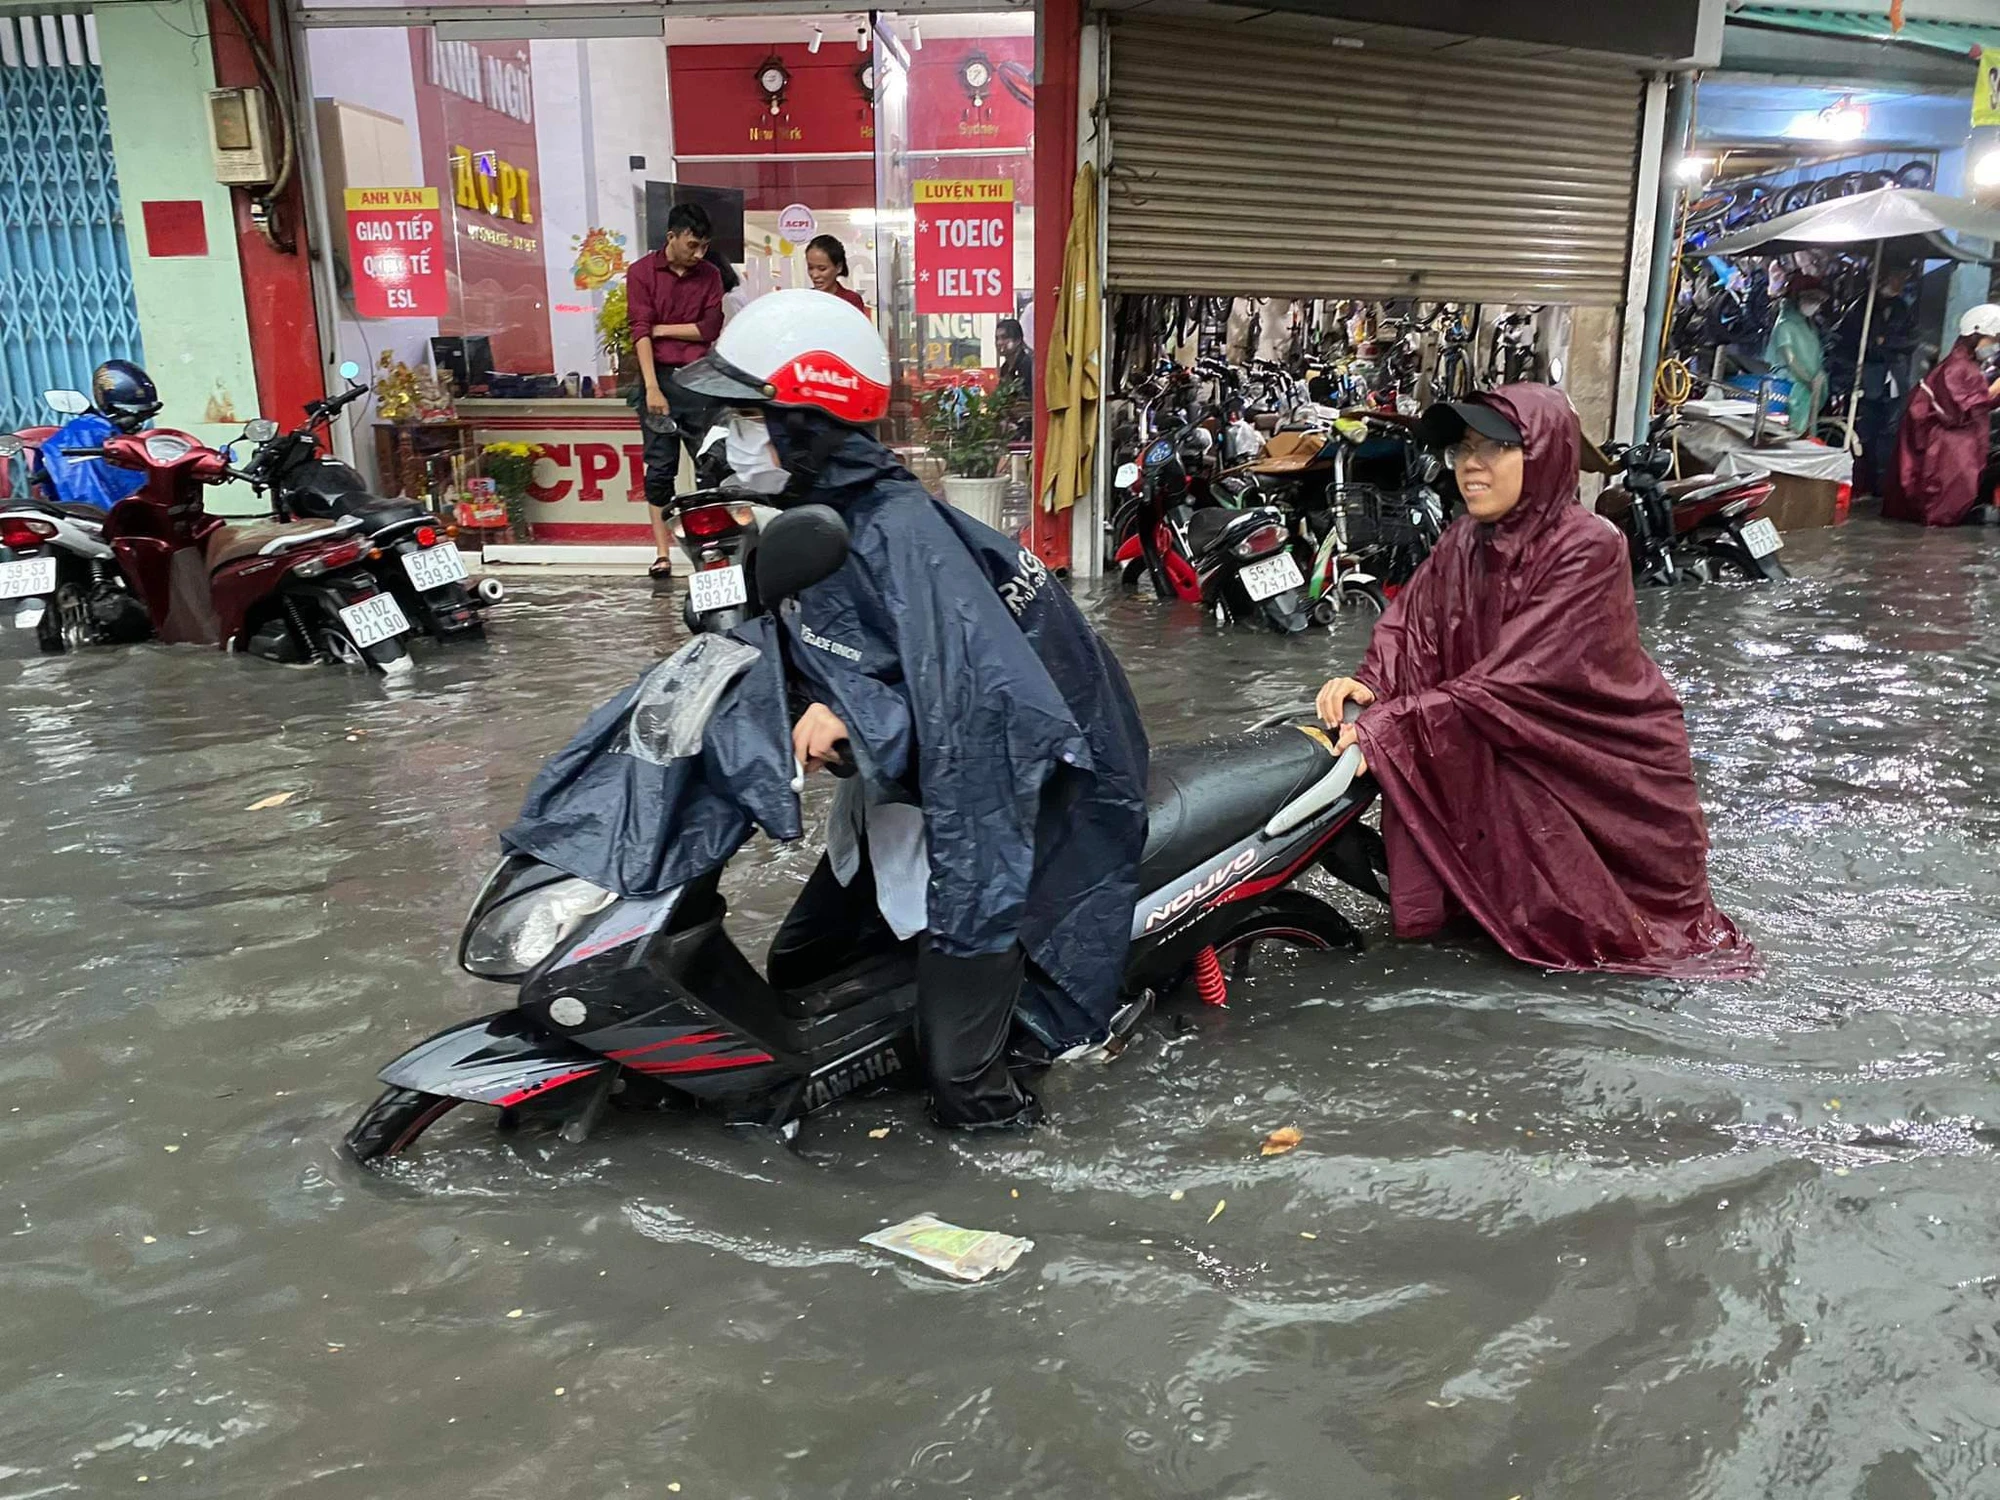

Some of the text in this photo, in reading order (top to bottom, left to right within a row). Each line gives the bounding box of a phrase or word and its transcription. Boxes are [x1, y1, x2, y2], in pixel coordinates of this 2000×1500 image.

[959, 121, 999, 138] Sydney
[361, 189, 422, 204] ANH VĂN
[454, 144, 533, 224] ACPI
[925, 181, 1003, 200] LUYỆN THI
[356, 213, 433, 241] GIAO TIẾP
[935, 218, 1004, 248] TOEIC
[409, 247, 432, 274] TẾ
[937, 268, 1002, 297] IELTS
[387, 289, 418, 309] ESL
[7, 562, 47, 579] 59-S3
[412, 547, 453, 571] 67-E1
[2, 577, 50, 597] 797.03
[414, 561, 462, 588] 539.31
[695, 569, 736, 591] 59-F2
[694, 585, 742, 609] 393.24
[350, 599, 391, 625] 61-D2
[355, 613, 405, 644] 221.90
[1144, 848, 1256, 930] NOUVO
[802, 1047, 902, 1111] YAMAHA
